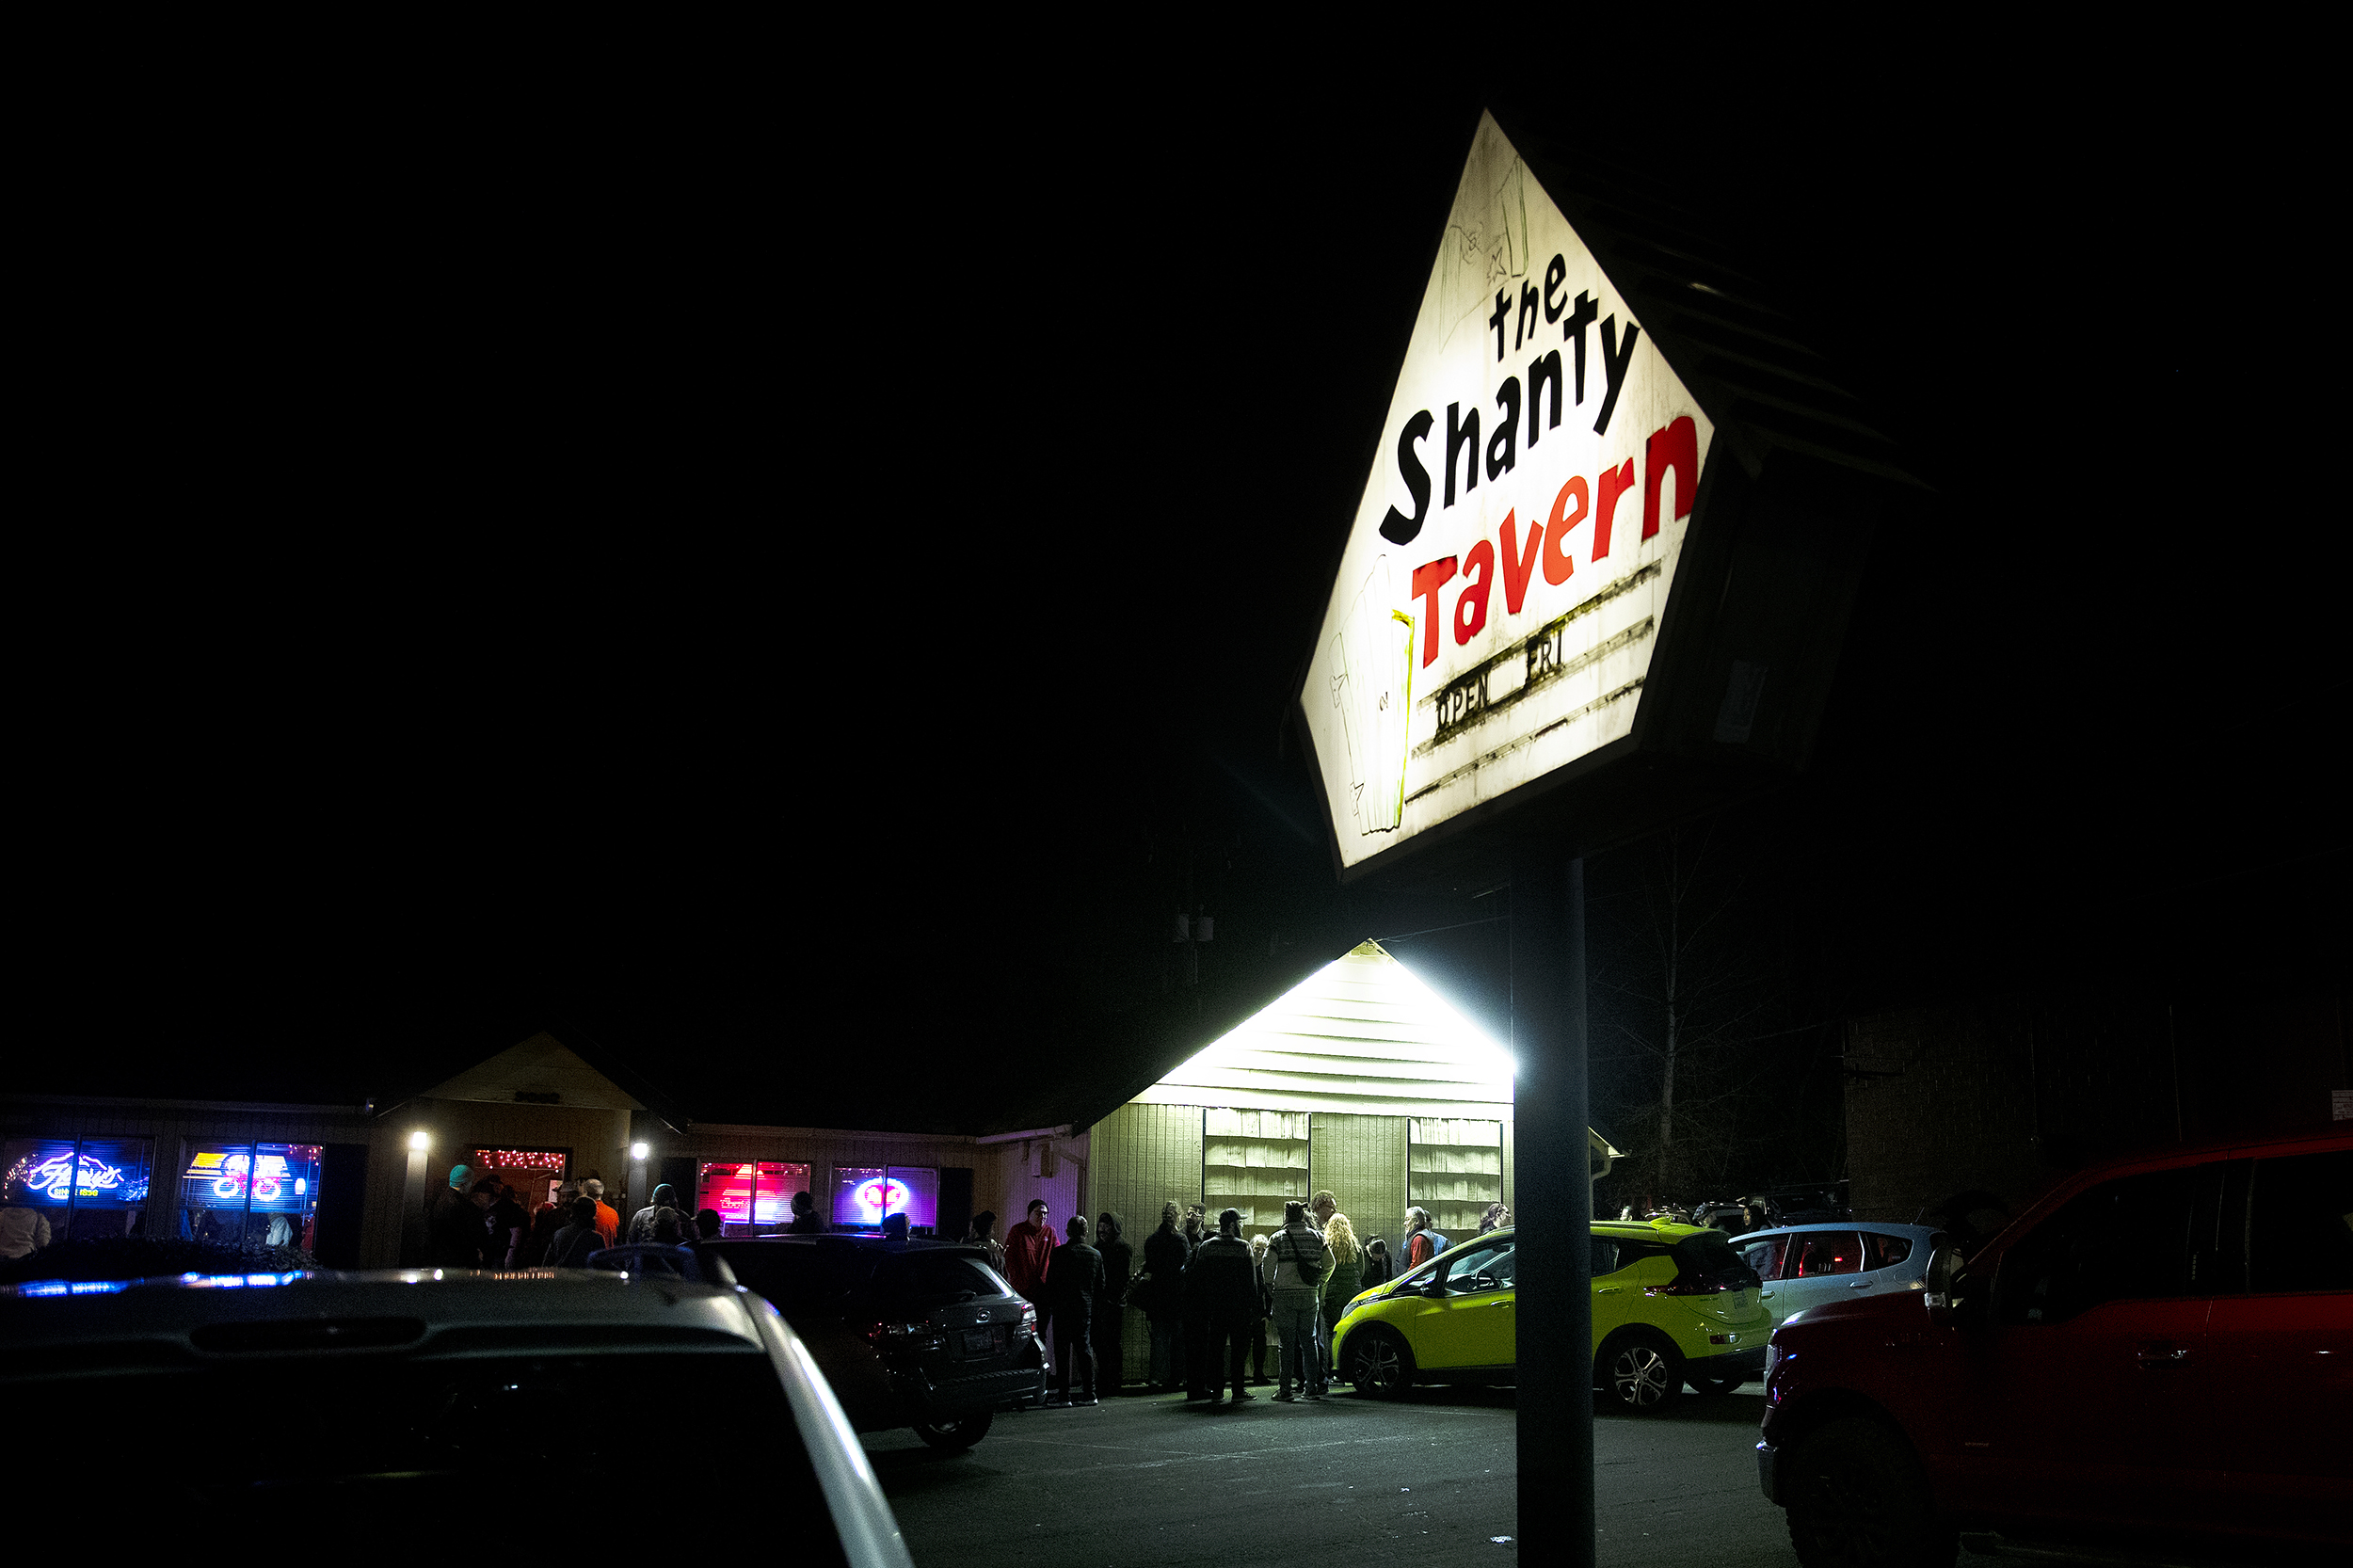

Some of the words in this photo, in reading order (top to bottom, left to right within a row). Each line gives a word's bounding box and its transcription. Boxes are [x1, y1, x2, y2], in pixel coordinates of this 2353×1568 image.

[1489, 253, 1569, 363] the
[1378, 289, 1641, 547] Shanty
[1412, 415, 1699, 669] Tavern
[1436, 672, 1490, 730] OPEN
[1526, 630, 1562, 681] FRI
